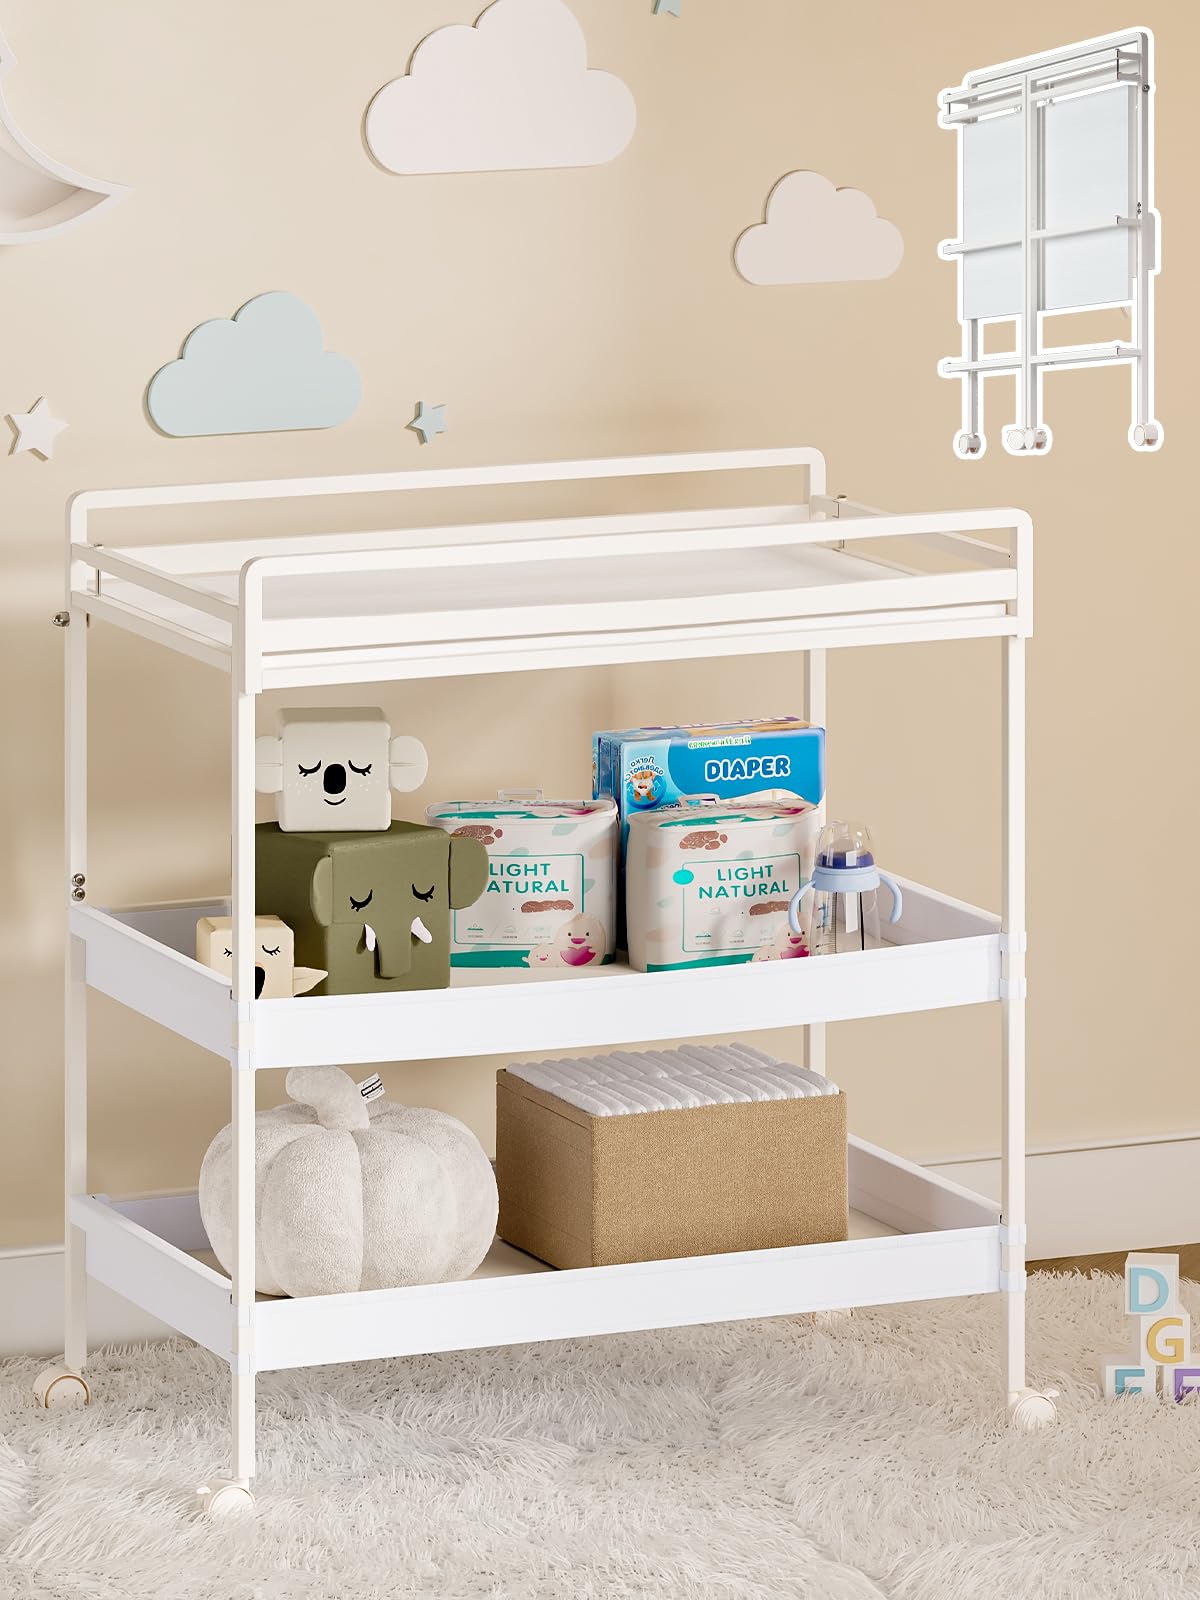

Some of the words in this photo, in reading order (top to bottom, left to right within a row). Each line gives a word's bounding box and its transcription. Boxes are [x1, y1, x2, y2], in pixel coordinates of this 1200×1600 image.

[705, 756, 790, 781] DIAPER
[489, 863, 551, 877] LIGHT
[717, 864, 774, 881] LIGHT
[486, 879, 570, 894] ATURAL
[698, 879, 790, 899] NATURAL
[1129, 1267, 1169, 1312] D
[1146, 1317, 1185, 1364] G
